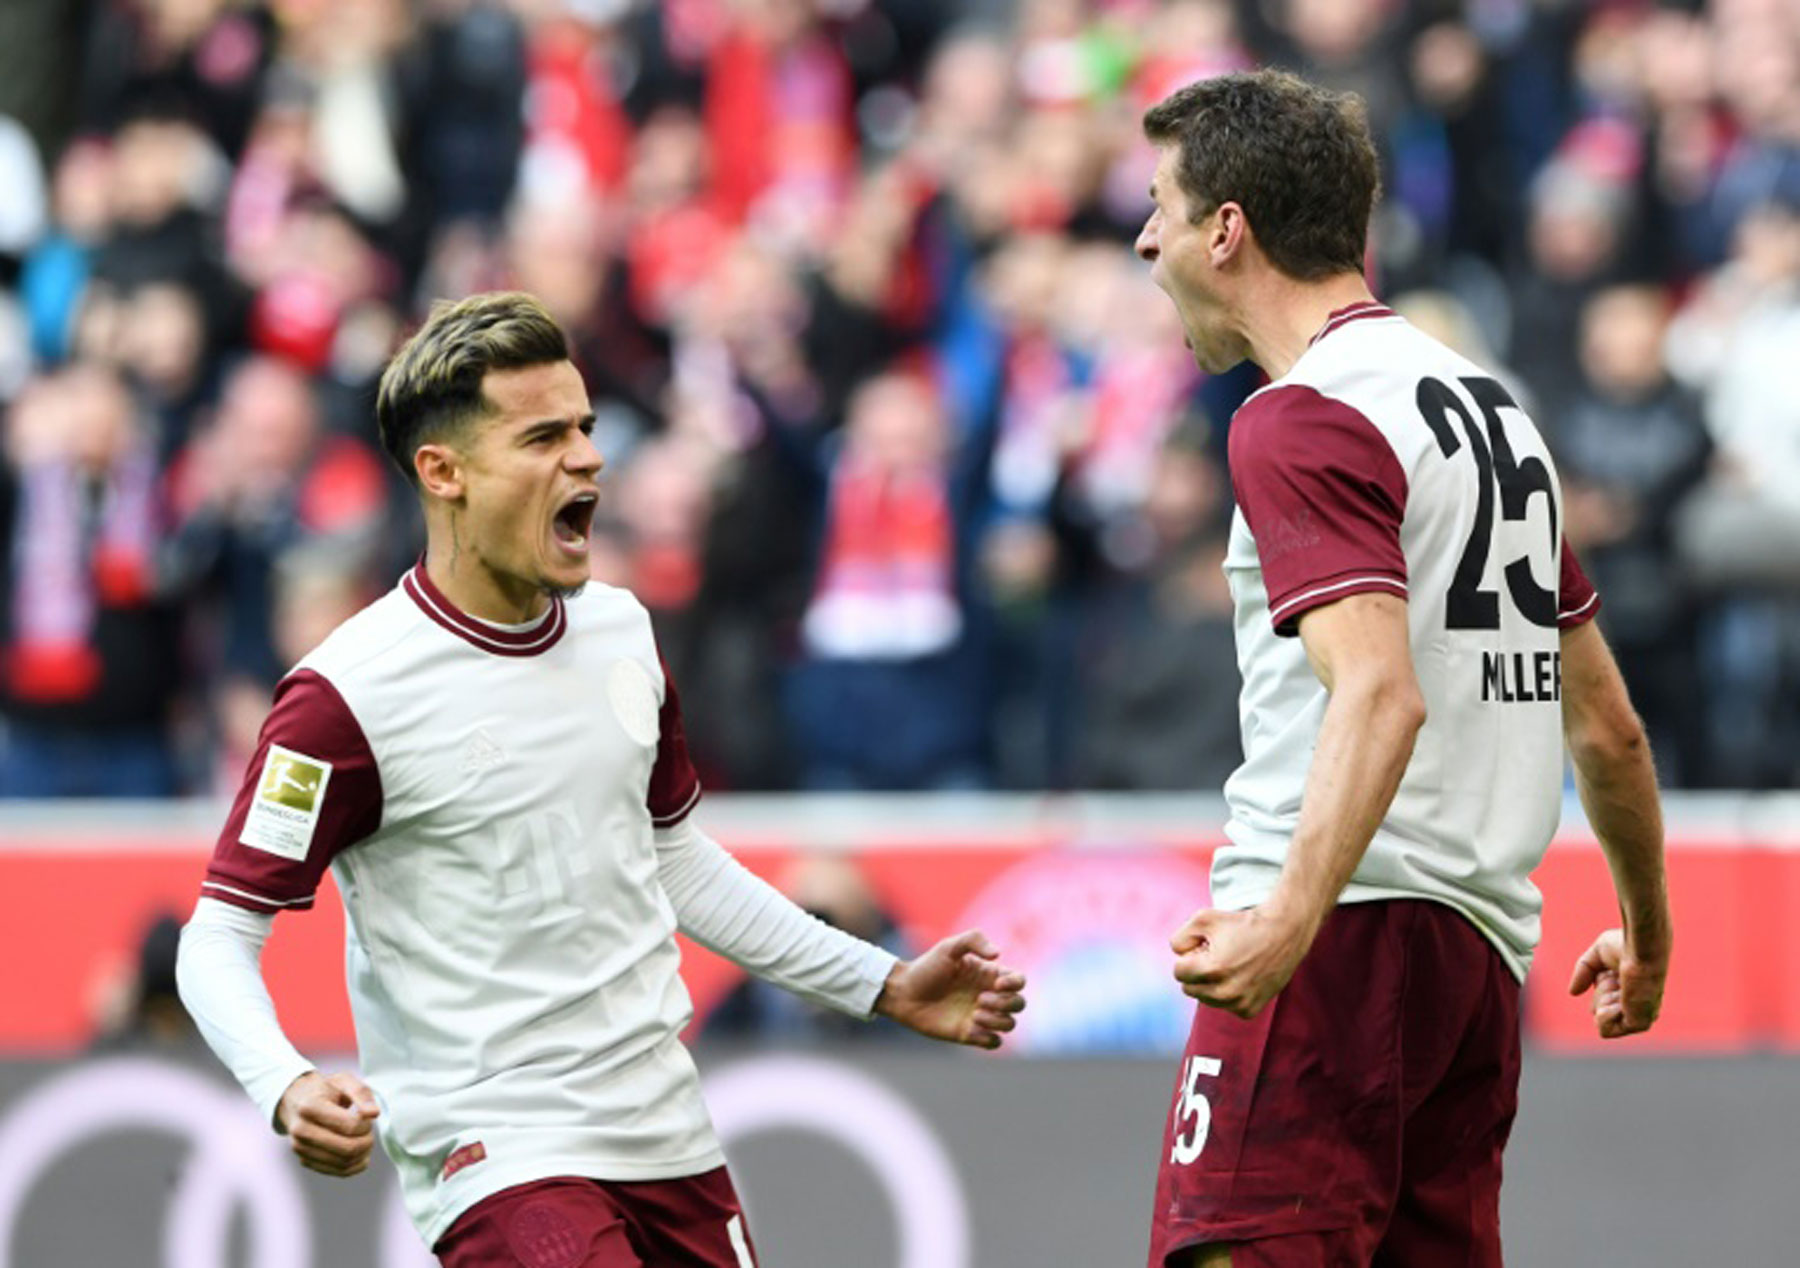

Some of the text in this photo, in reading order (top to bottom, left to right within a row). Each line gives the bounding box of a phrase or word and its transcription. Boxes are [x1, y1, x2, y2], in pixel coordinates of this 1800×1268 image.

[1416, 376, 1559, 630] 25
[1482, 651, 1561, 702] MLLE
[1170, 1054, 1222, 1164] 5
